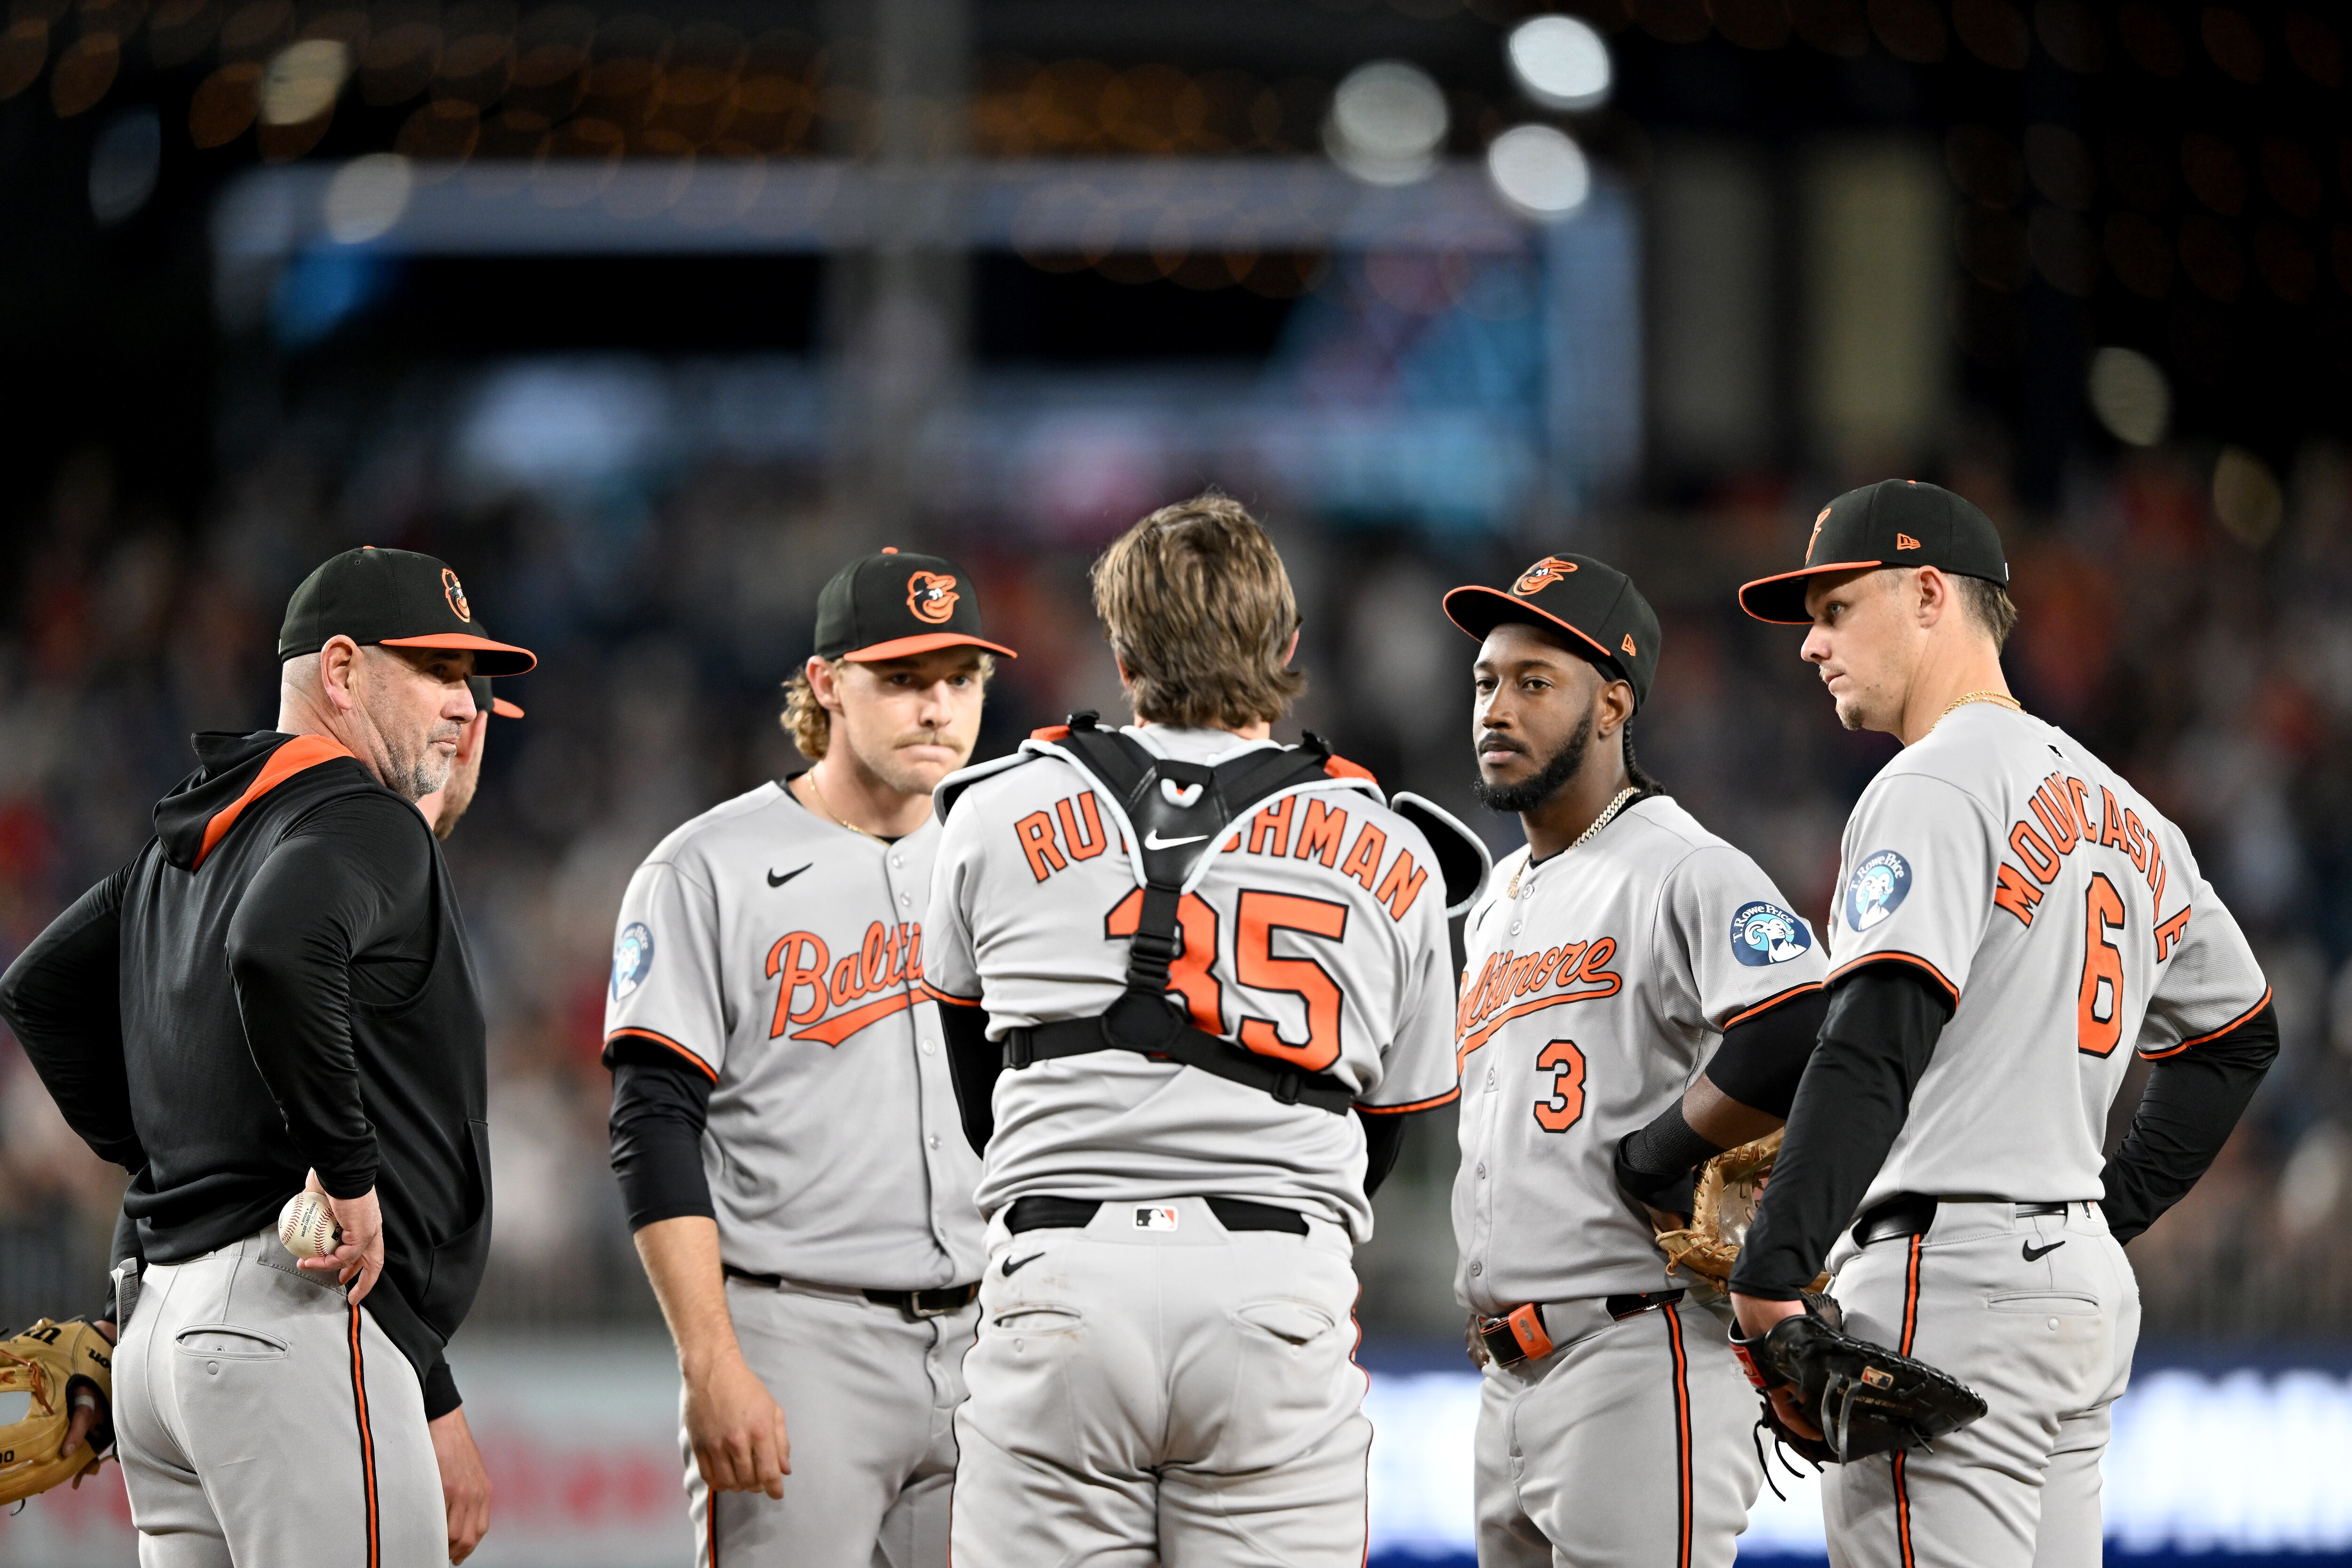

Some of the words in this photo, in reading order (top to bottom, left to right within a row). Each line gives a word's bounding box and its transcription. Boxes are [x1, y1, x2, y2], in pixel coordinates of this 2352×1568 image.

[1014, 790, 1428, 923] RUHMAN
[1884, 853, 1904, 879] Price
[1734, 906, 1765, 928] Rowe
[1765, 904, 1794, 924] Price
[2078, 871, 2125, 1059] 6
[765, 921, 924, 1039] Balti
[1457, 937, 1619, 1043] altimore
[1533, 1039, 1586, 1134] 3
[309, 1201, 317, 1215] BASEBALL
